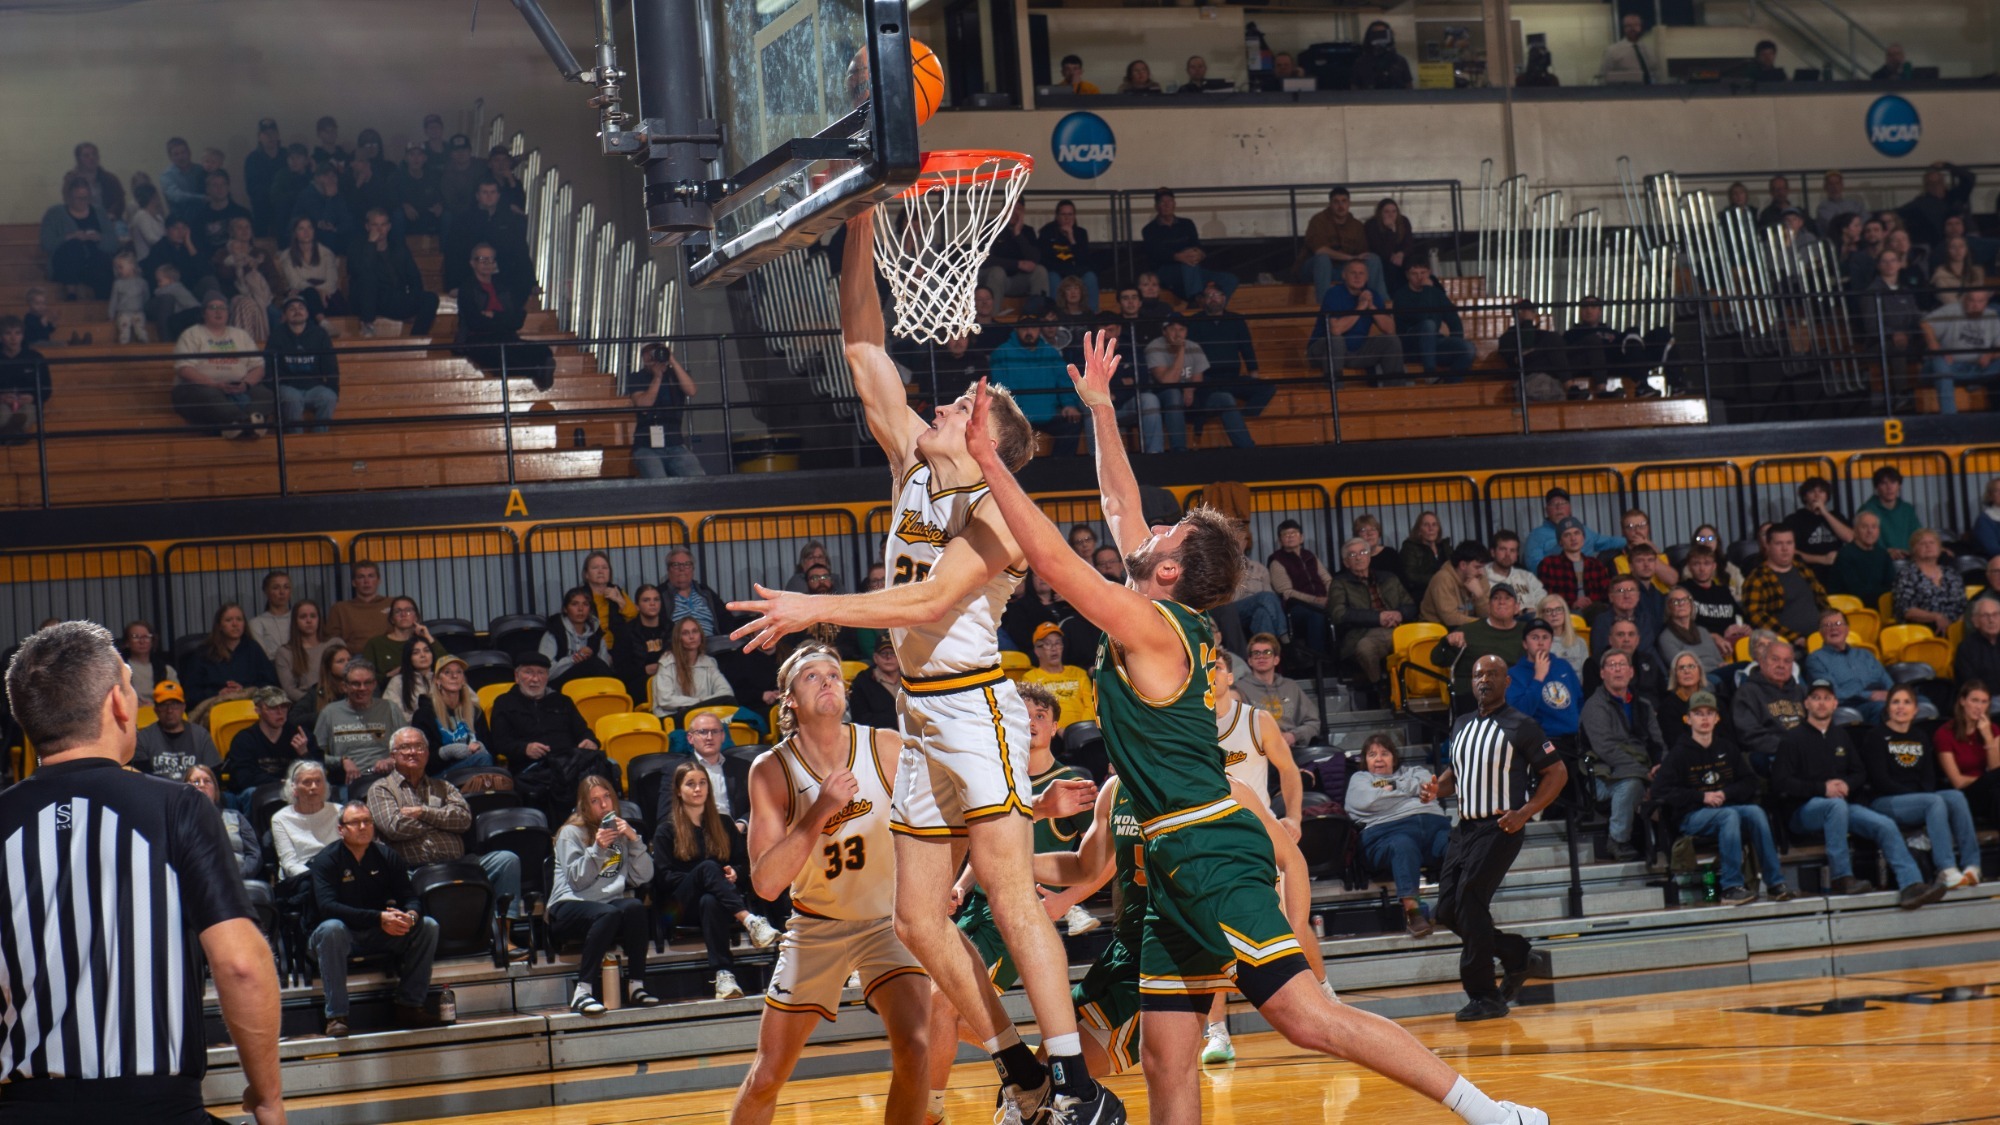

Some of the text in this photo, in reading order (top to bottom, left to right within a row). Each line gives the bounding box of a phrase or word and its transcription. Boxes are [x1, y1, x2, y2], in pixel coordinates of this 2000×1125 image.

[1871, 125, 1920, 143] NCAA
[1058, 144, 1115, 162] NCAA
[1884, 419, 1904, 445] B
[504, 488, 529, 517] A
[333, 734, 373, 743] HUSKIES
[181, 755, 196, 766] GO
[1116, 825, 1141, 837] MIC
[823, 833, 866, 880] 33
